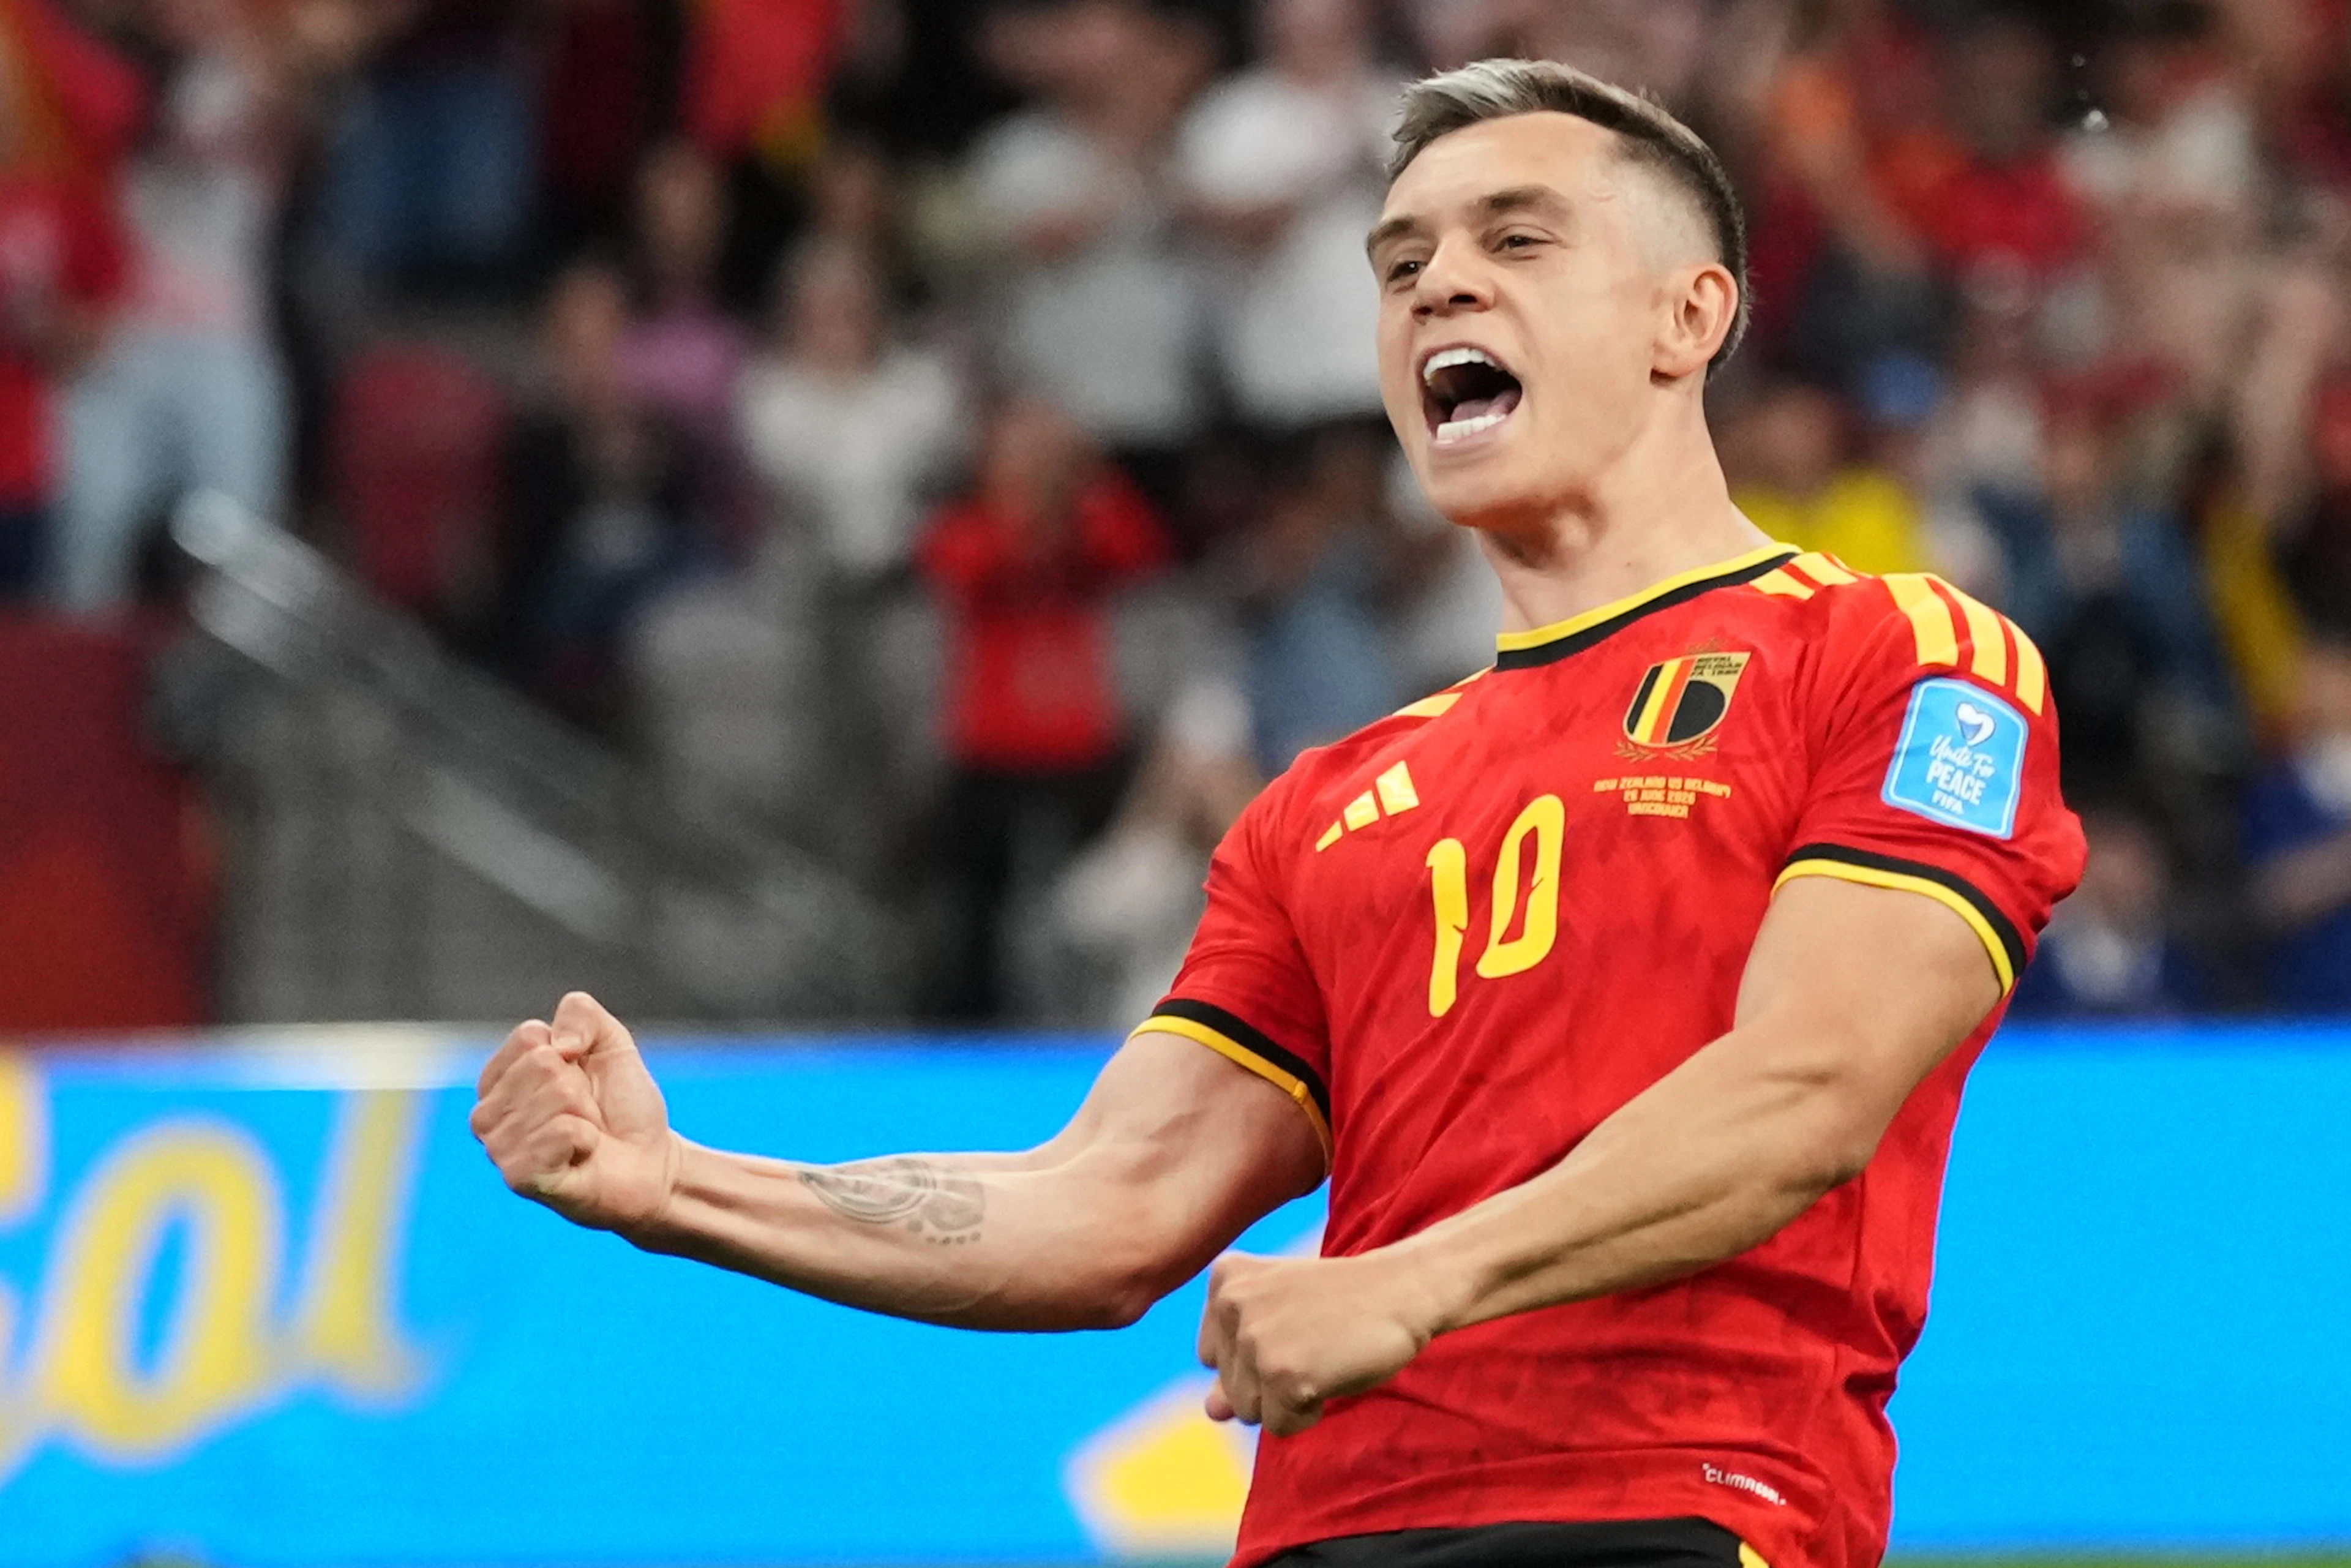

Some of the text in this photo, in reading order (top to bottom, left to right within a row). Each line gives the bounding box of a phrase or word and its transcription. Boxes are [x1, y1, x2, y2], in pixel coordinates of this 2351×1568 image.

[1930, 735, 1973, 767] Unite
[1594, 779, 1618, 792] NEW
[1619, 776, 1666, 789] ZEALAND
[1668, 777, 1682, 790] VS
[1640, 789, 1665, 801] JUNE
[1667, 790, 1695, 805] 2026
[1926, 760, 1985, 806] PEACE
[1628, 802, 1688, 818] VANCOUVER
[1932, 790, 1963, 814] FIFA
[1426, 794, 1565, 1018] 10
[0, 1044, 432, 1472] ol
